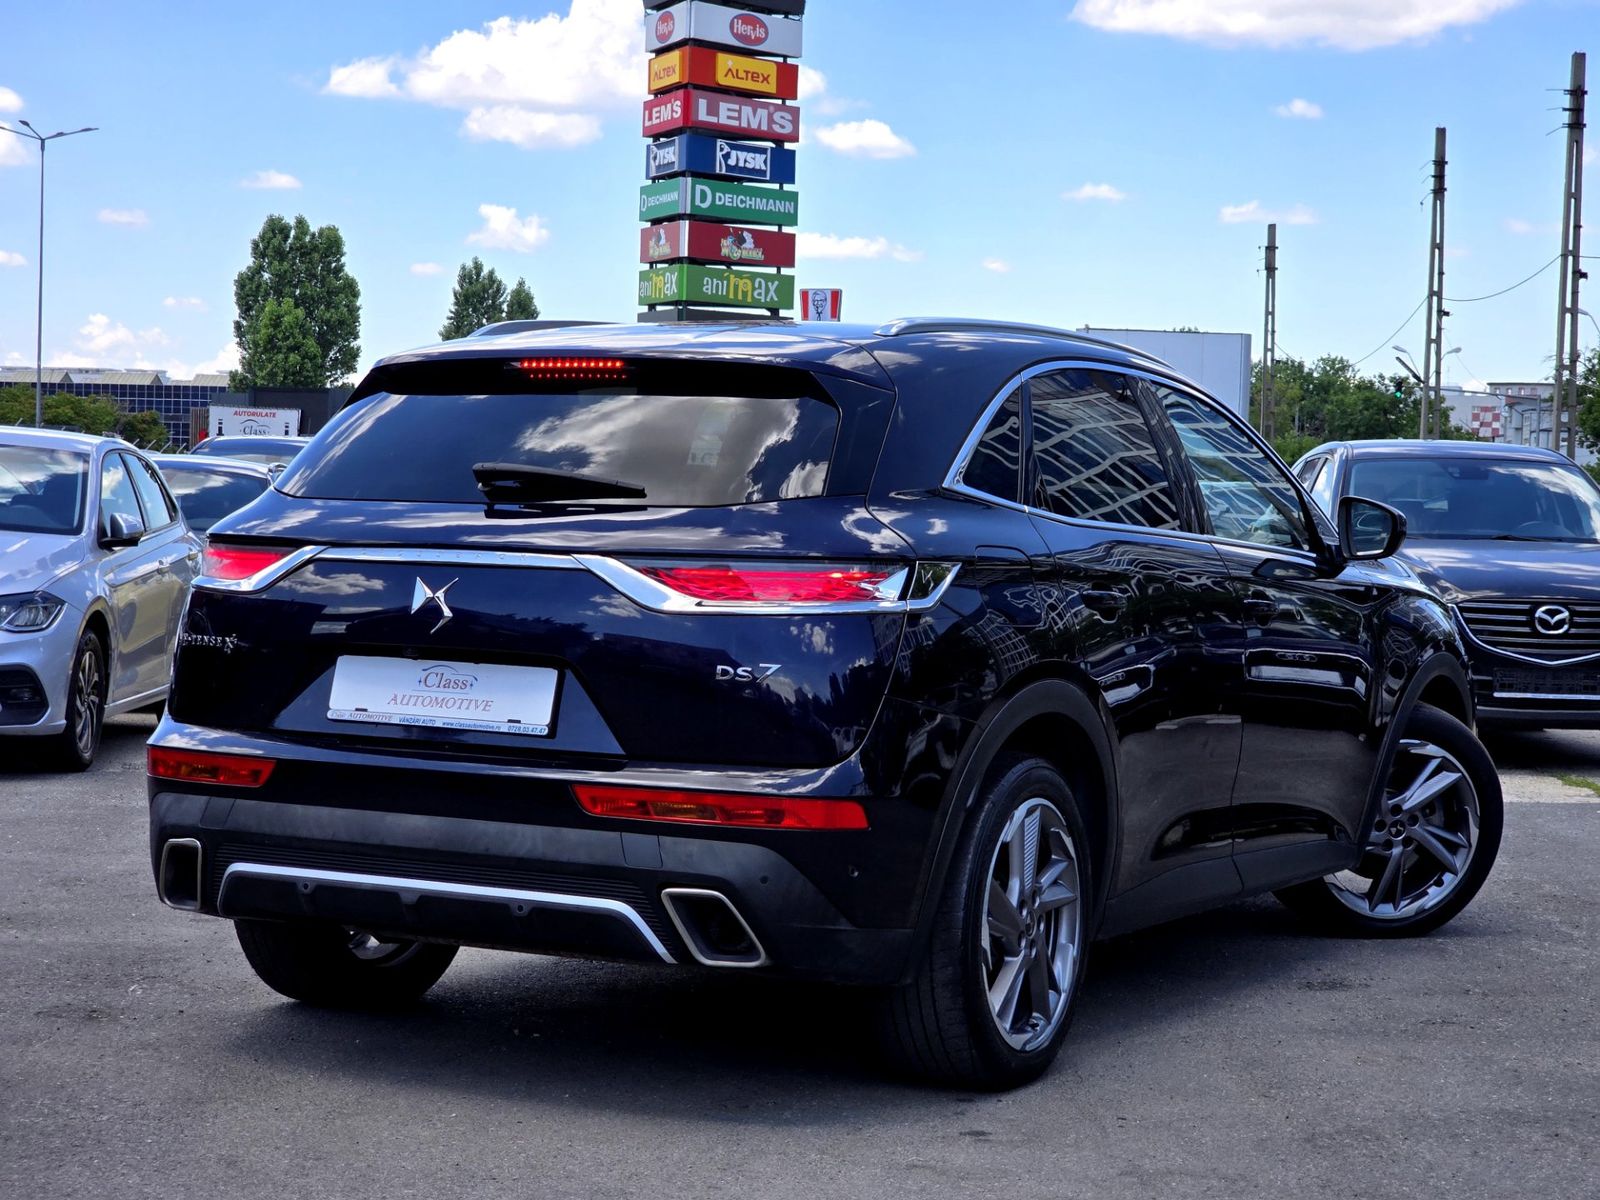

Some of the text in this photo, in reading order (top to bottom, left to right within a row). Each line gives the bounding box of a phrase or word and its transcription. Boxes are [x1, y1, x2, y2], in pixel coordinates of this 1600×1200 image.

[734, 19, 766, 39] Hervis
[644, 99, 682, 127] LEM'S
[698, 98, 793, 134] LEM'S
[656, 146, 676, 166] JYSK
[727, 150, 767, 171] JYSK
[647, 191, 679, 207] DEICHMANN
[715, 192, 794, 214] DEICHMANN
[639, 271, 678, 298] animax
[702, 272, 779, 303] animax
[233, 410, 277, 418] AUTORULATE
[243, 425, 267, 436] Class
[423, 671, 469, 690] Class
[387, 693, 494, 712] AUTOMOTIVE
[349, 712, 393, 722] AUTOMOTIVE
